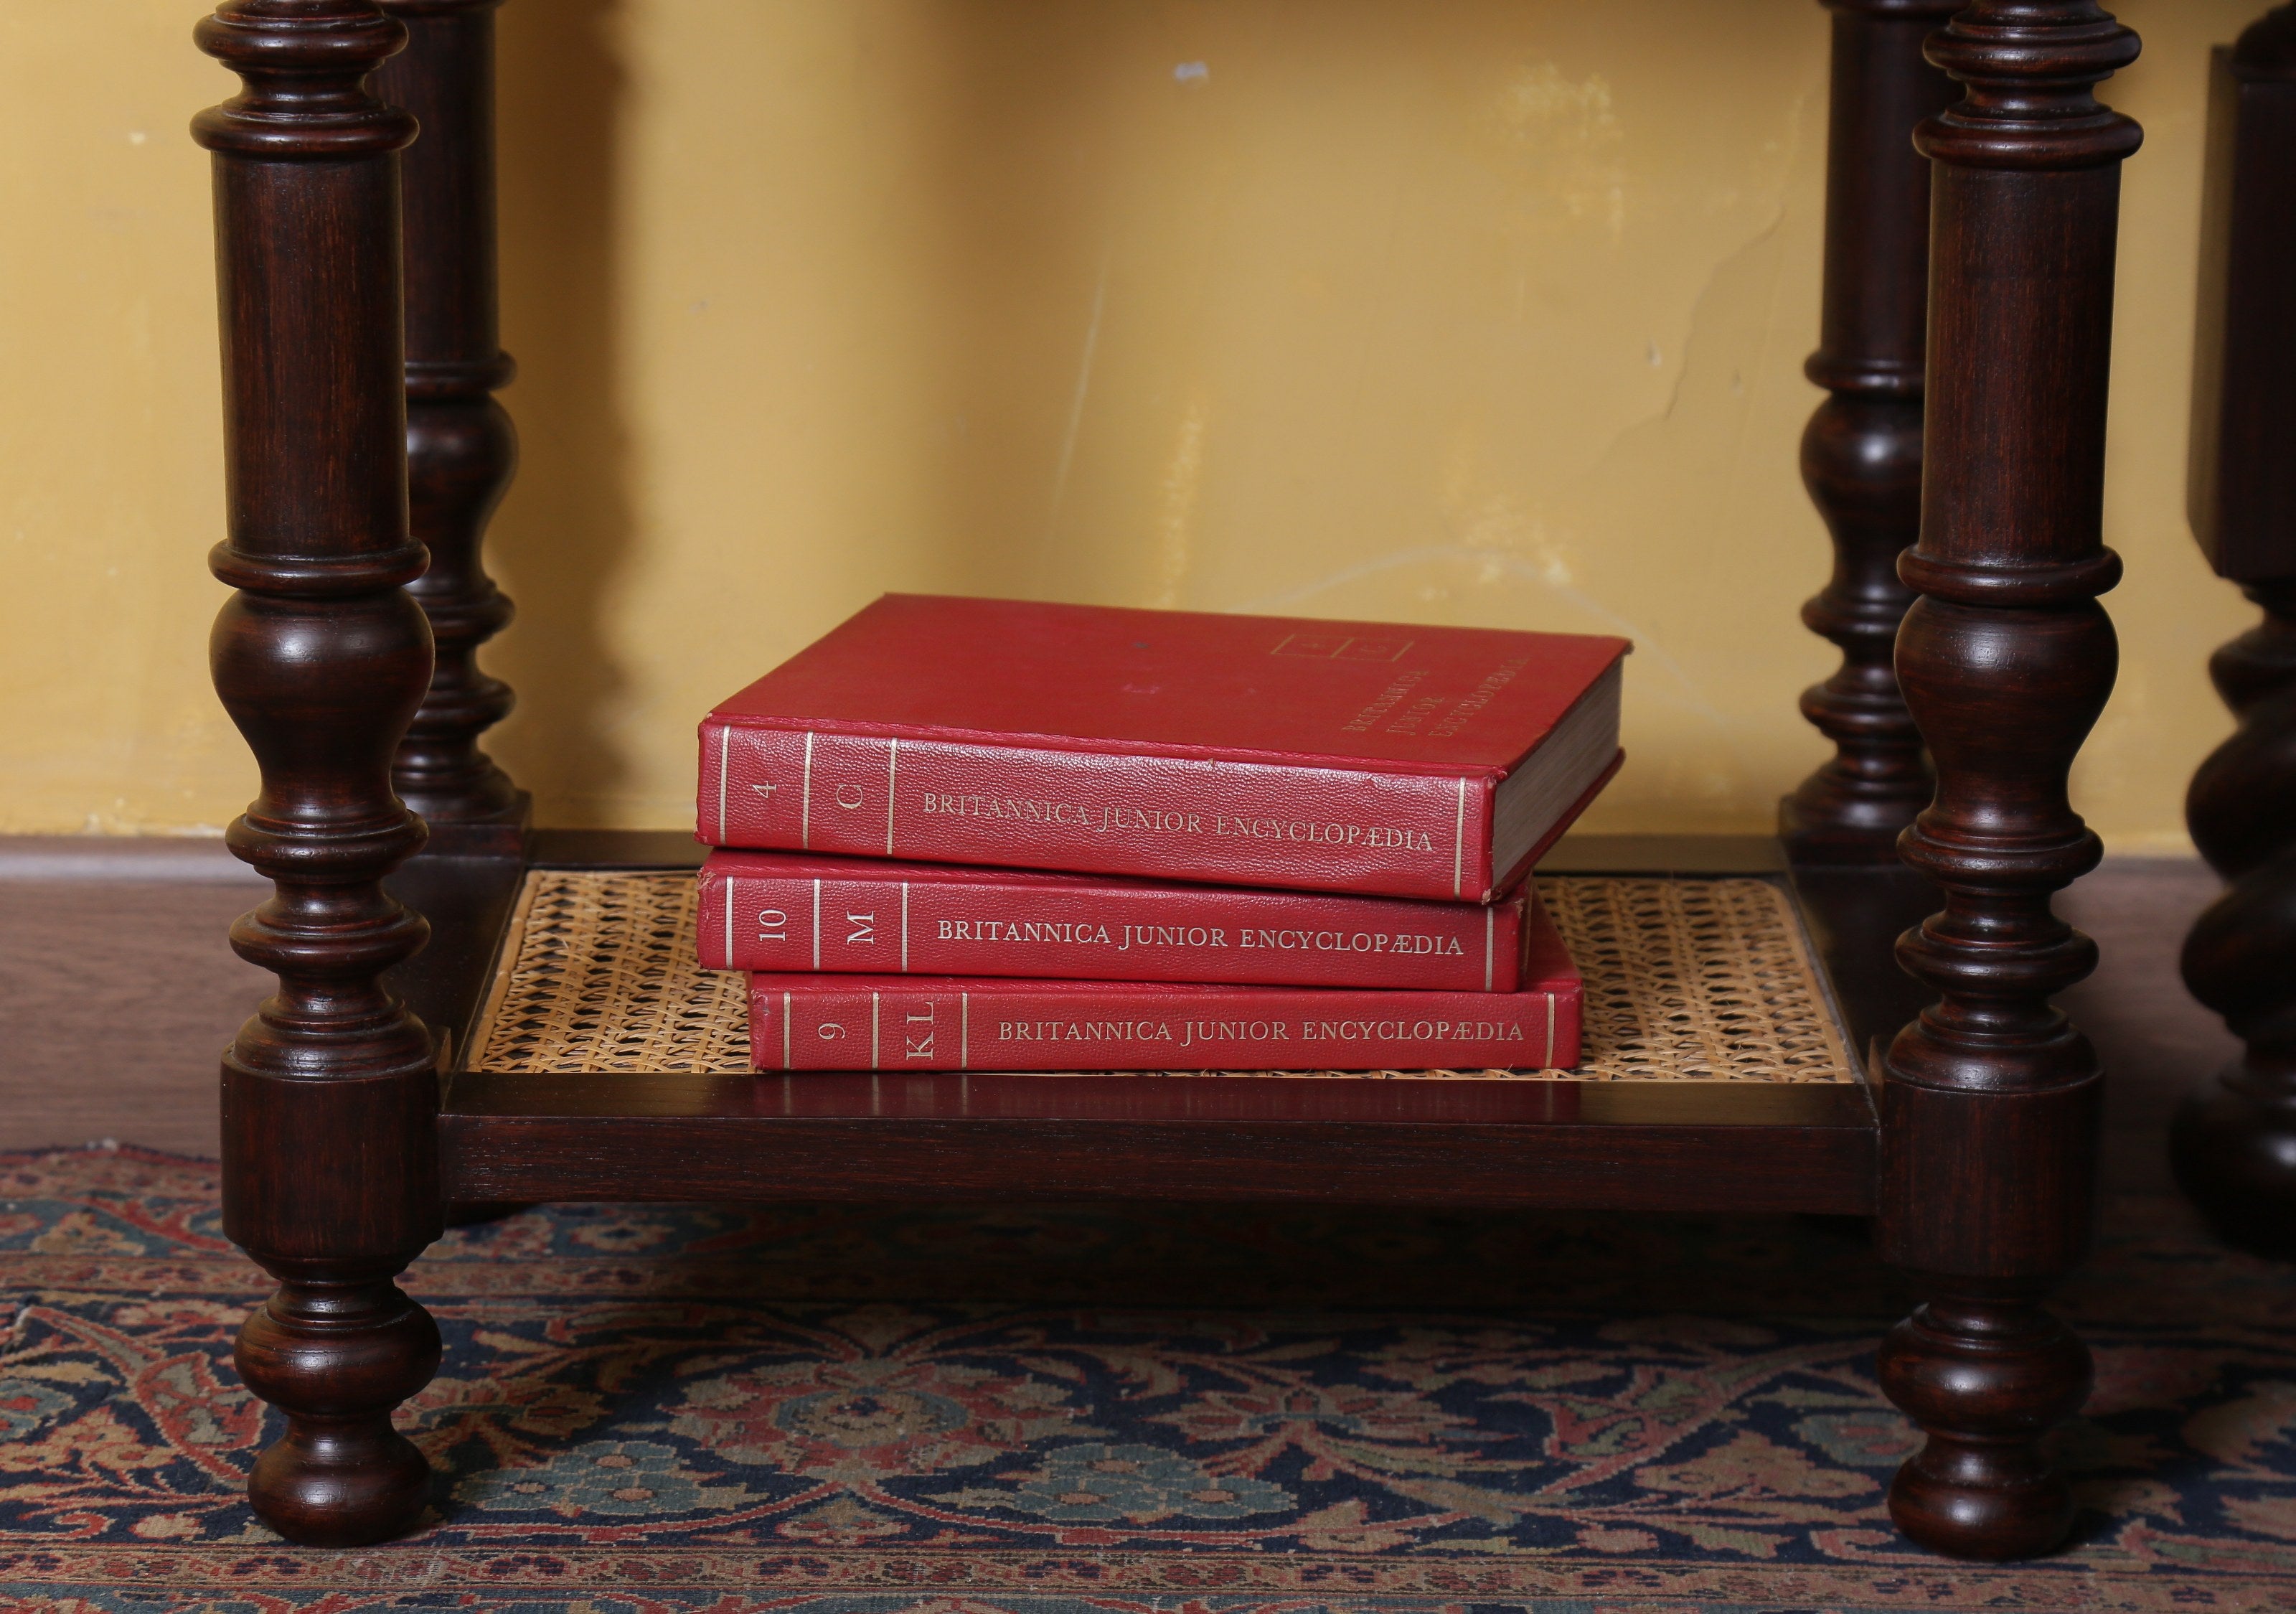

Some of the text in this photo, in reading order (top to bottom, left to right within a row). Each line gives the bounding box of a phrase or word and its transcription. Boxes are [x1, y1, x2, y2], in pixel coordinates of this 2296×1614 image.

[752, 780, 776, 797] 4
[836, 784, 862, 808] C
[923, 792, 1432, 850] BRITANNICA JUNIOR ENCYCLOPÆDIA
[759, 908, 786, 942] 10
[847, 909, 874, 944] M
[937, 919, 1463, 955] BRITANNICA JUNIOR ENCYCLOPÆDIA
[818, 1022, 844, 1038] 9
[997, 1021, 1523, 1046] BRITANNICA JUNIOR ENCYCLOPÆDIA
